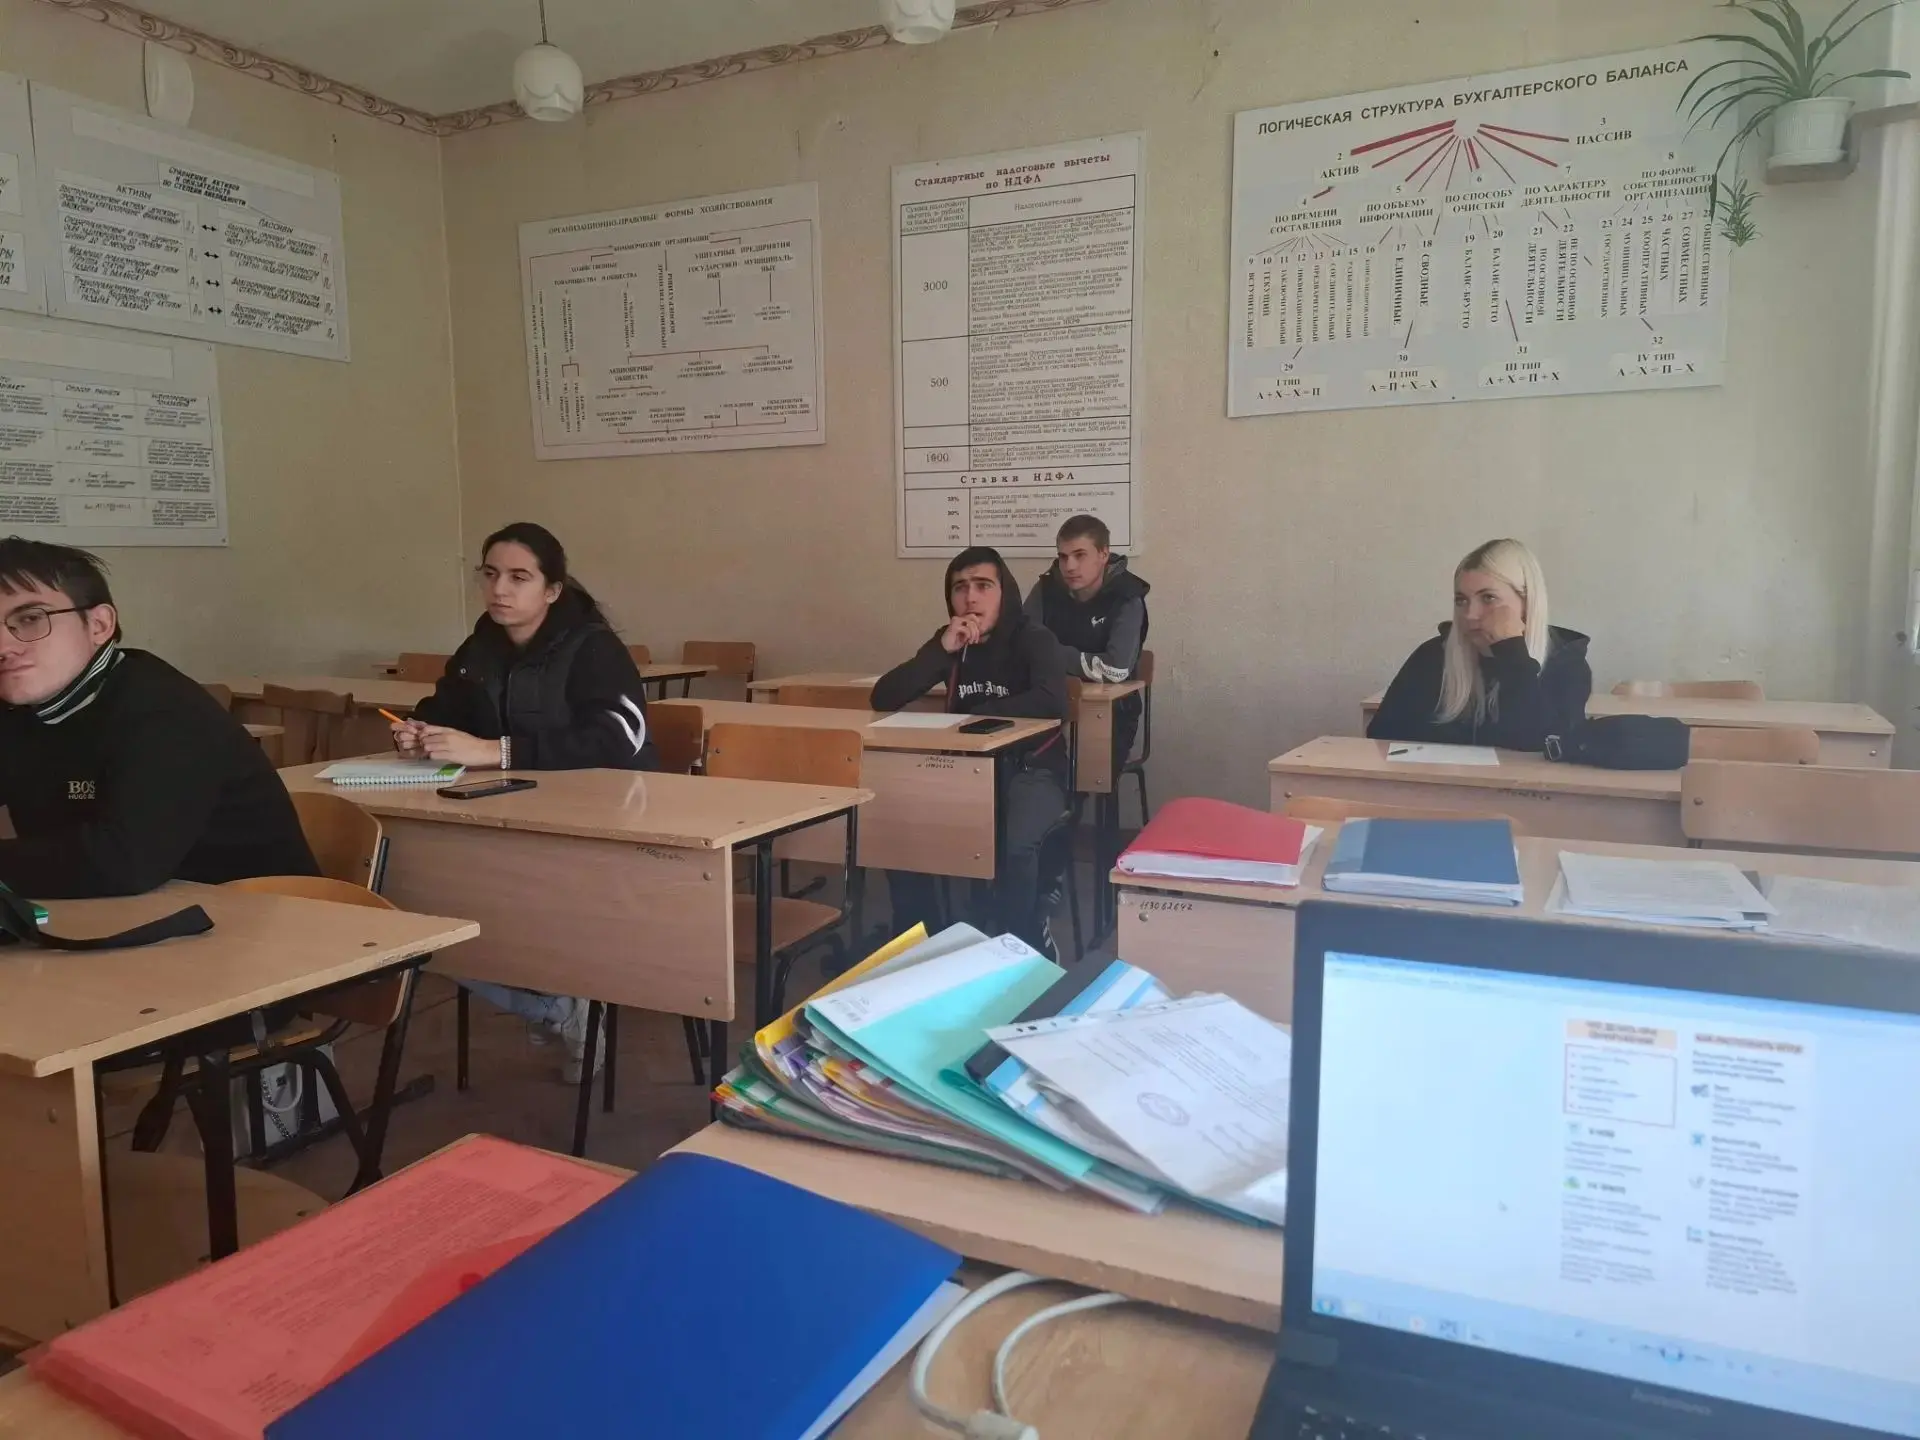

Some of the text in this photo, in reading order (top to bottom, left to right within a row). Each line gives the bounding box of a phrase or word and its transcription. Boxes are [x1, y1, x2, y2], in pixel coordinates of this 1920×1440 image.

[1258, 59, 1689, 135] ЛОГИЧЕСКАЯ СТРУКТУРА БУХГАЛТЕРСКОГО БАЛАНСА
[1600, 117, 1606, 126] 3
[1576, 129, 1632, 145] ПАССИВ
[1337, 152, 1342, 161] 2
[1668, 152, 1674, 160] 8
[914, 153, 1110, 187] Стандартные налоговые вычеты
[1320, 164, 1359, 179] АКТИВ
[1565, 165, 1571, 174] 7
[1641, 165, 1697, 179] ПО ФОРМЕ
[985, 175, 1042, 190] по НДФЛ
[1477, 175, 1482, 183] 6
[1623, 173, 1715, 191] СОБСТВЕННОСТИ
[116, 185, 152, 199] АКТИВЫ
[1396, 185, 1401, 193] 5
[1524, 179, 1606, 195] ПО ХАРАКТЕРУ
[1301, 198, 1307, 206] 4
[1445, 188, 1513, 203] ПО СПОСОБУ
[1520, 189, 1611, 208] ДЕЯТЕЛЬНОСТИ
[664, 208, 694, 218] ФОРМЫ
[700, 197, 773, 214] ХОЗЯЙСТВОВАНИЯ
[1366, 198, 1426, 212] ПО ОБЪЕМУ
[1452, 200, 1505, 214] ОЧИСТКИ
[1274, 208, 1337, 224] ПО ВРЕМЕНИ
[1359, 208, 1433, 224] ИНФОРМАЦИИ
[1621, 218, 1633, 226] 24
[1641, 215, 1653, 224] 25
[1661, 214, 1673, 222] 26
[1681, 212, 1694, 220] 27
[1270, 219, 1342, 235] СОСТАВЛЕНИЯ
[1533, 227, 1543, 235] 21
[1563, 225, 1574, 233] 22
[1602, 220, 1613, 228] 23
[1465, 234, 1475, 243] 19
[1493, 230, 1504, 239] 20
[1348, 247, 1358, 255] 15
[1396, 243, 1406, 251] 17
[1422, 240, 1433, 248] 18
[1280, 256, 1289, 264] 11
[1297, 253, 1306, 261] 12
[1314, 251, 1324, 260] 13
[1659, 228, 1671, 281] ЧАСТНЫХ
[1678, 226, 1691, 303] СОВМЕСТНЫХ
[1699, 223, 1712, 307] ОБЩЕСТВЕННЫХ
[1567, 238, 1578, 321] НЕ ПО ОСНОВНОЙ
[1600, 233, 1611, 319] ГОСУДАРСТВЕННЫХ
[1619, 233, 1631, 316] МУНИЦИПАЛЬНЫХ
[1639, 230, 1652, 315] КООПЕРАТИВНЫХ
[922, 281, 948, 292] 3000
[1419, 253, 1430, 307] СВОДНЫЕ
[1490, 247, 1500, 323] БАЛАНС-НЕТТО
[1525, 242, 1536, 324] ДЕЯТЕЛЬНОСТИ
[1556, 239, 1567, 321] ДЕЯТЕЛЬНОСТИ
[1393, 256, 1404, 326] ЕДИНИЧНЫЕ
[1462, 249, 1472, 329] БАЛАНС-БРУТТО
[1651, 336, 1663, 345] 32
[1517, 346, 1528, 354] 31
[1399, 354, 1408, 362] 30
[1284, 363, 1293, 371] 29
[930, 377, 949, 387] 500
[960, 473, 1074, 484] Ставки НДФЛ
